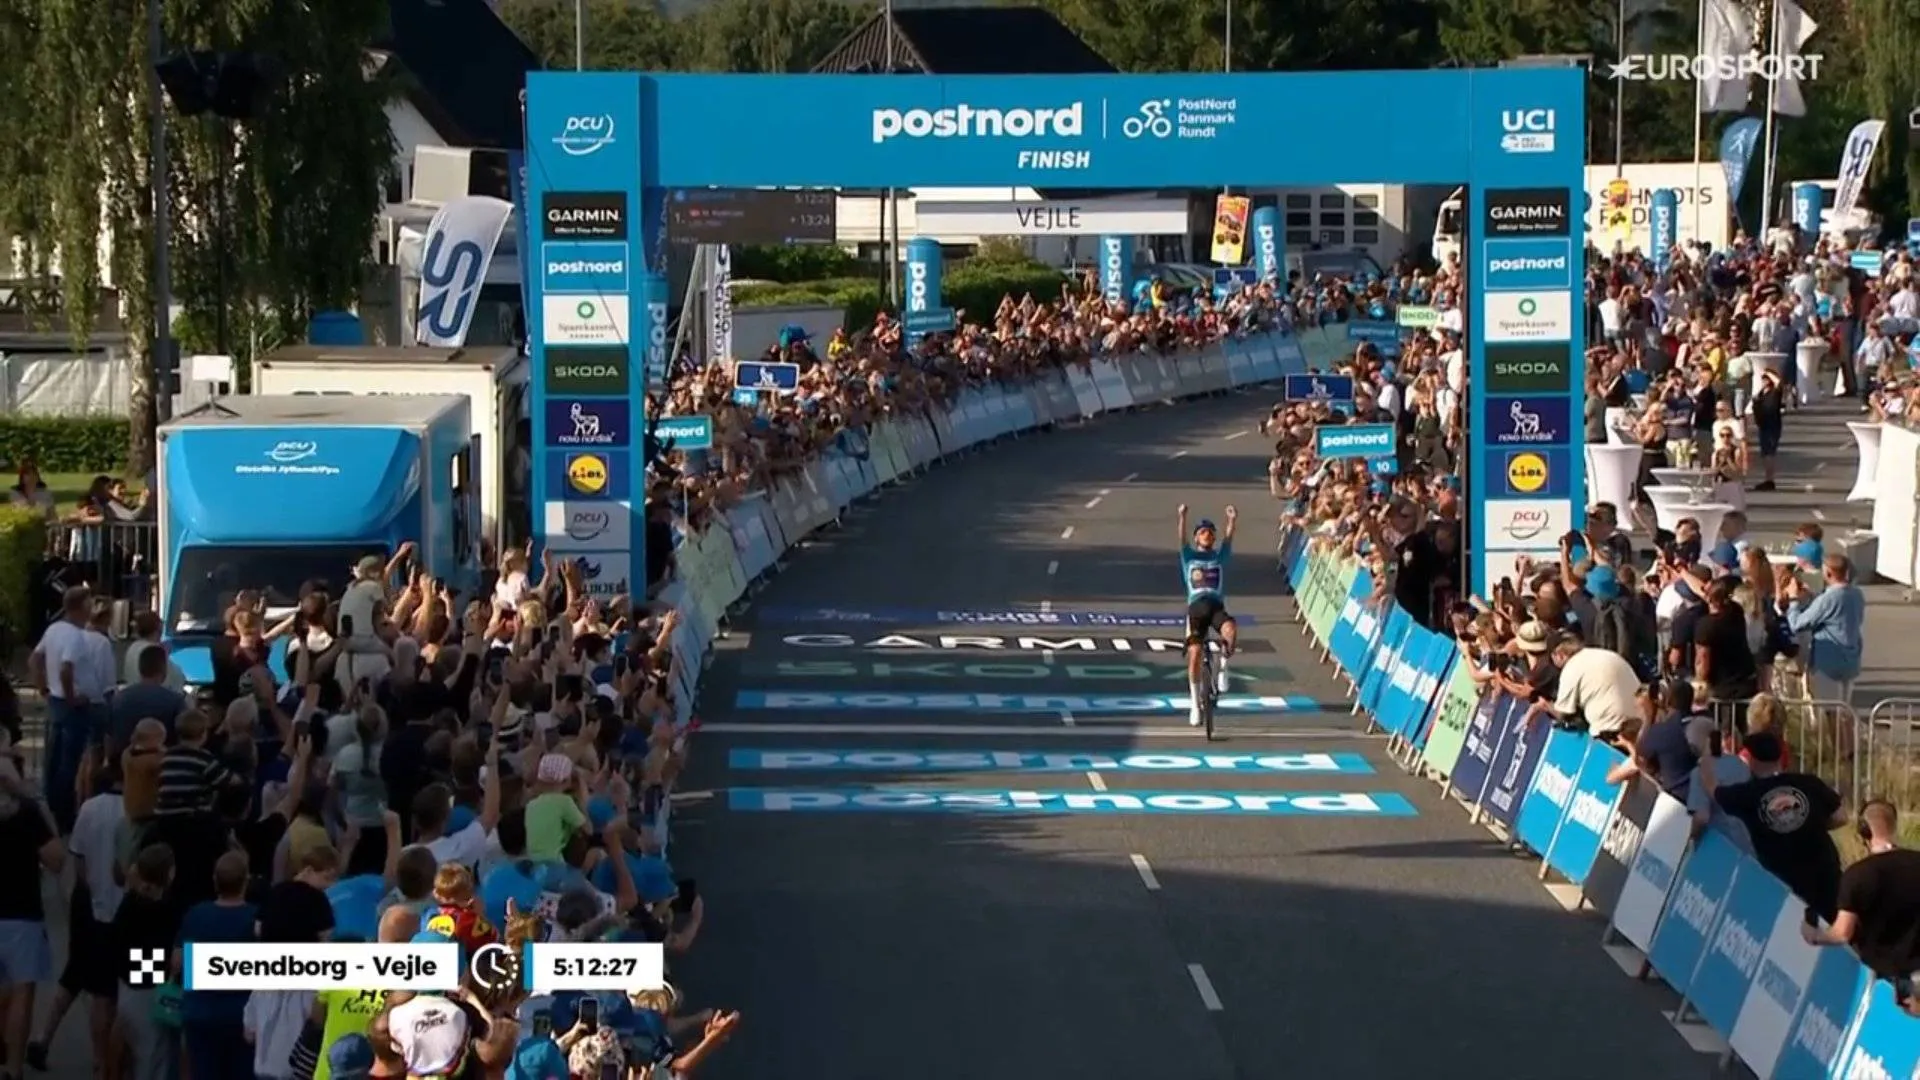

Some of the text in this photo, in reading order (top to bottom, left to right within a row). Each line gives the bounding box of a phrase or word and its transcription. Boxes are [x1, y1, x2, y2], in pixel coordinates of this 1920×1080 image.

[1177, 98, 1237, 111] PostNord
[566, 117, 604, 130] DCU
[872, 102, 1083, 143] postnord
[1177, 112, 1236, 125] Danmark
[1502, 109, 1555, 132] UCI
[1177, 126, 1217, 139] Rundt
[1017, 151, 1091, 169] FINISH
[547, 208, 620, 222] GARMIN
[1016, 207, 1082, 230] VEJLE
[1490, 204, 1562, 220] GARMIN
[548, 260, 623, 274] postnord
[1490, 256, 1565, 272] postnord
[1322, 432, 1389, 447] postnord
[1375, 462, 1390, 473] 10
[1513, 510, 1541, 522] DCU
[761, 751, 1341, 770] postnord
[763, 791, 1381, 812] postnord
